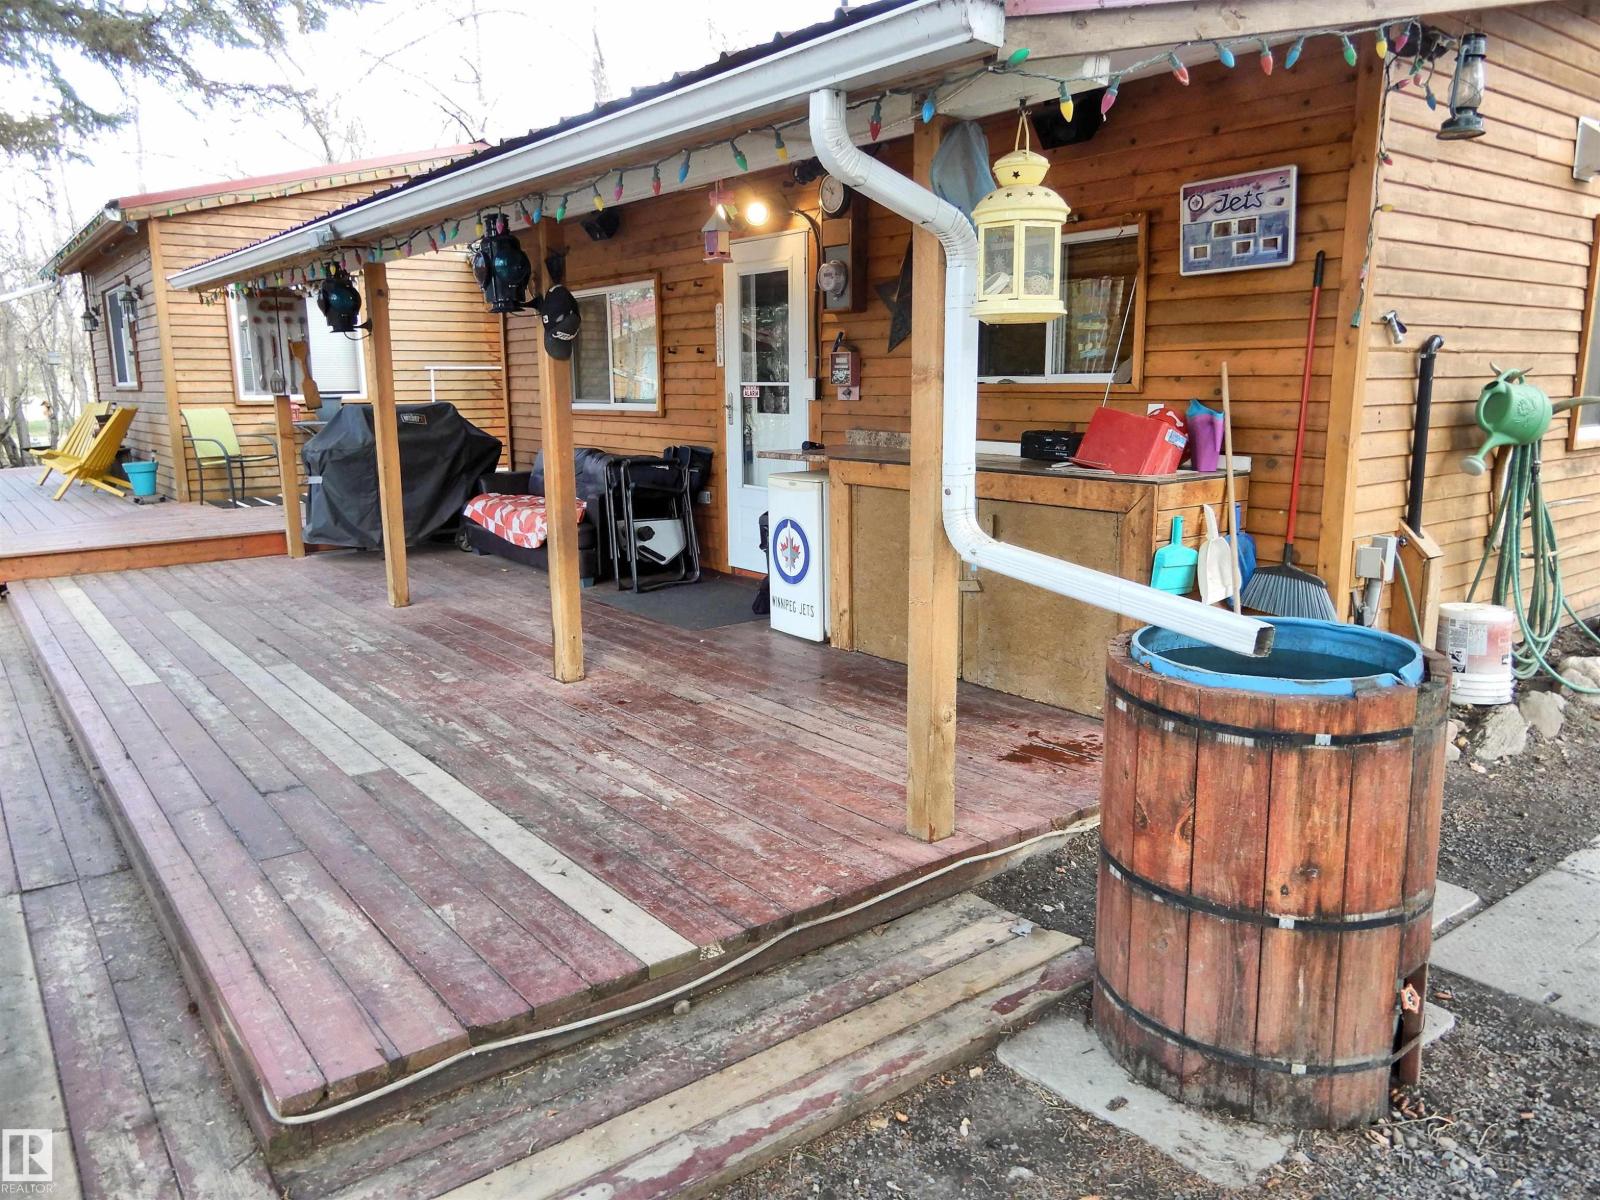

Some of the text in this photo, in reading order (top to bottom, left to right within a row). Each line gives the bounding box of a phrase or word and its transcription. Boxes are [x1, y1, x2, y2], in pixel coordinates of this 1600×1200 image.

[1214, 190, 1264, 213] Jets
[772, 595, 815, 618] WINNIPEG JETS
